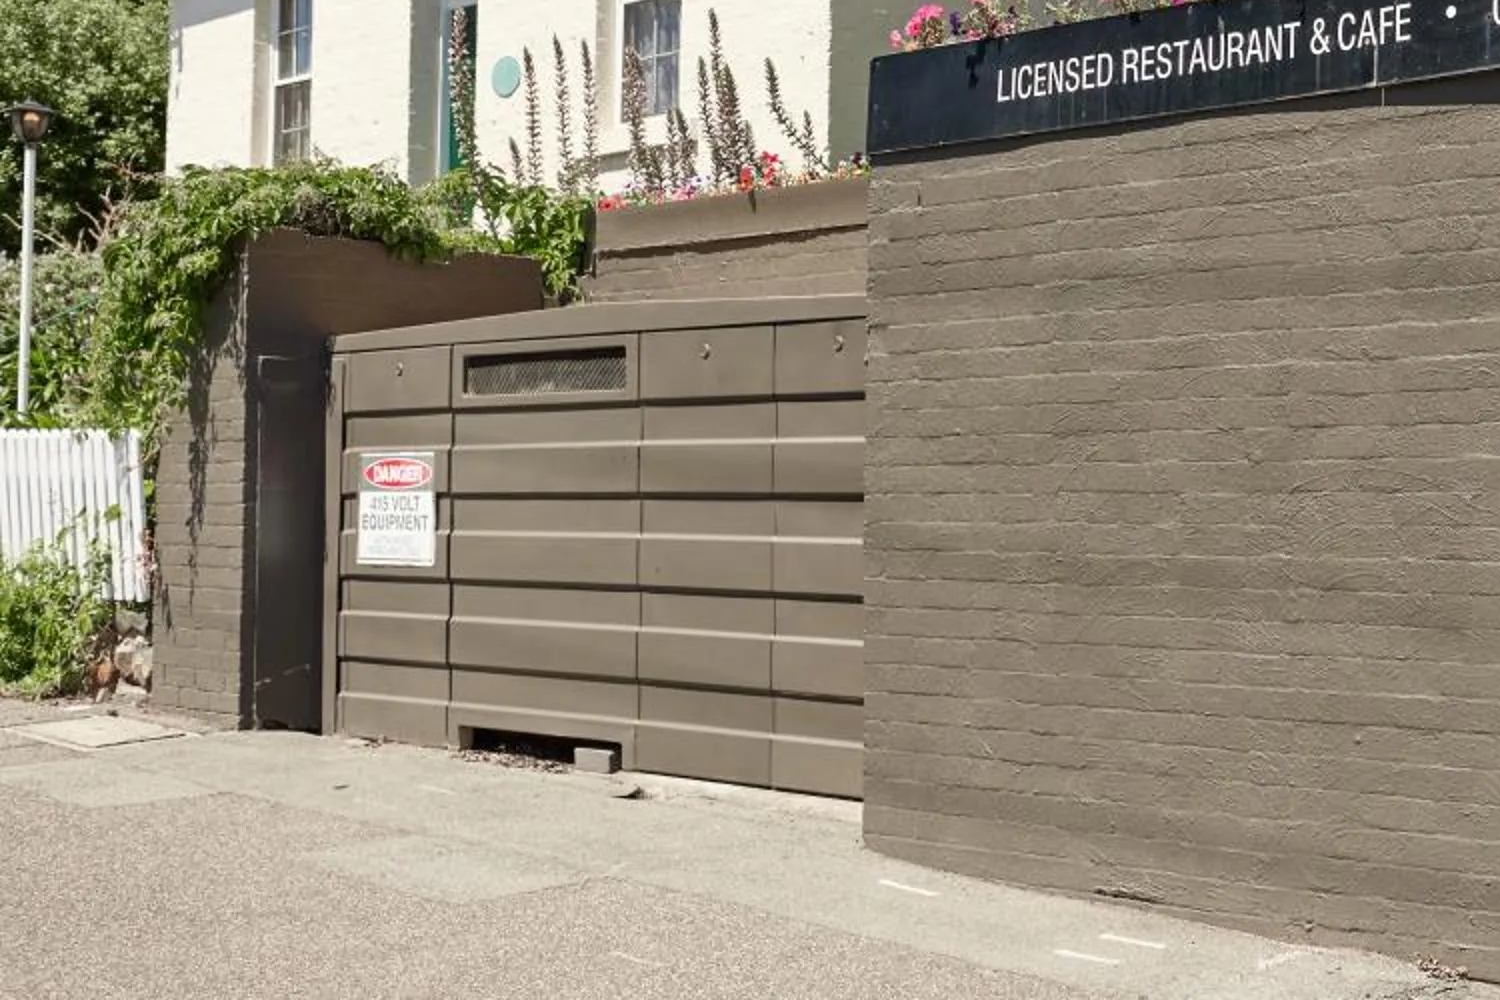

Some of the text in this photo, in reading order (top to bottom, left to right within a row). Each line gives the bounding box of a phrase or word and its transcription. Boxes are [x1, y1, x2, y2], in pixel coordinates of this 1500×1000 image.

[997, 51, 1113, 102] LICENSED
[1122, 20, 1301, 84] RESTAURANT
[1310, 18, 1331, 55] &
[1337, 2, 1412, 51] CAFE
[373, 464, 423, 483] DANGER
[391, 495, 420, 511] VOLT
[362, 514, 428, 531] EQUIPMENT
